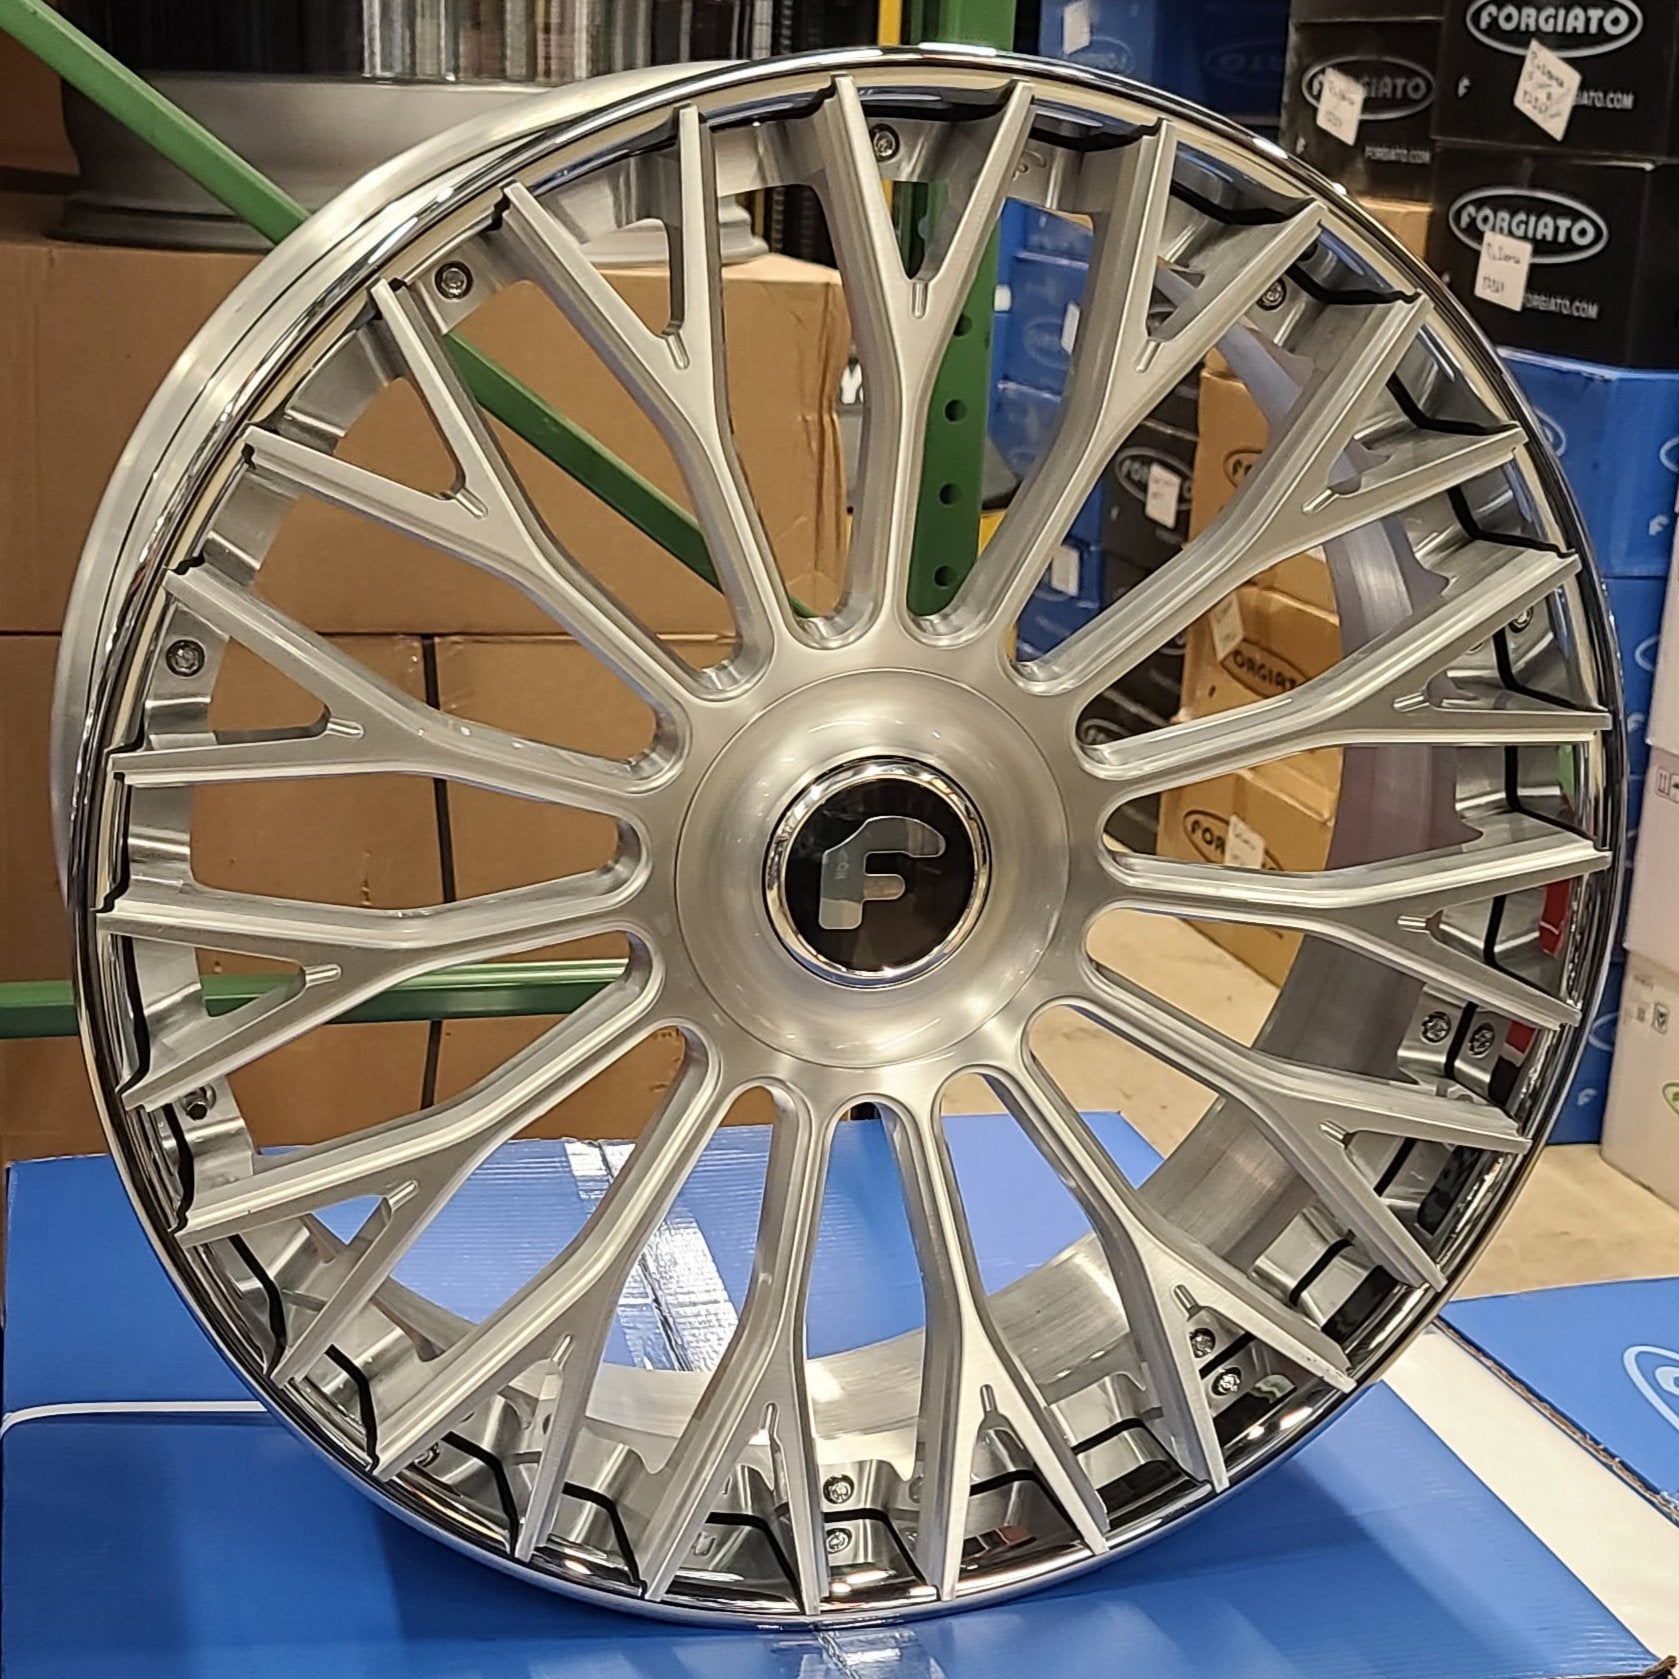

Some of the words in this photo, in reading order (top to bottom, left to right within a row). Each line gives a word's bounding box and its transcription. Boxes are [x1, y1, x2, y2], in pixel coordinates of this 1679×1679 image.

[1479, 3, 1630, 35] FORGIATO
[1577, 89, 1635, 109] IATO.COM
[1460, 204, 1596, 246] FORGIATO
[1526, 292, 1600, 319] ORGIATO.COM
